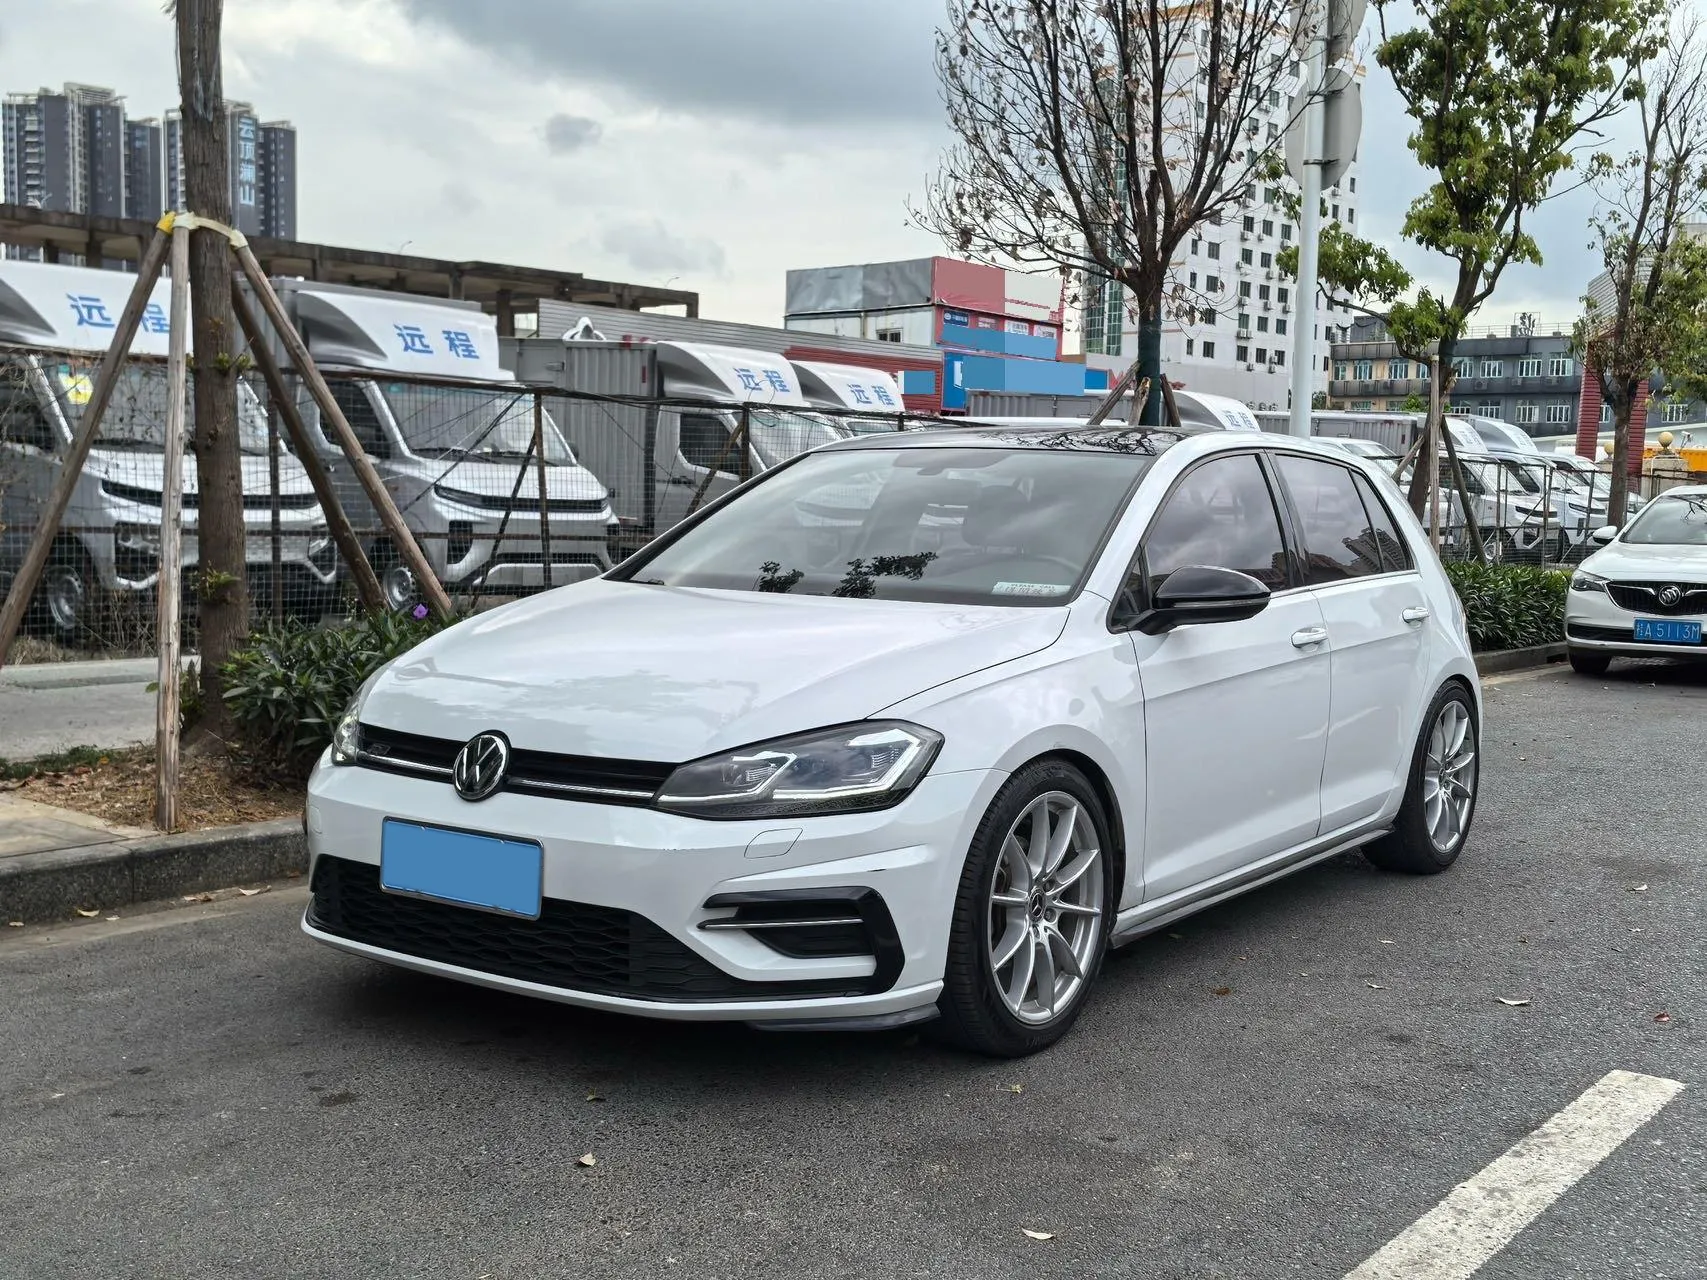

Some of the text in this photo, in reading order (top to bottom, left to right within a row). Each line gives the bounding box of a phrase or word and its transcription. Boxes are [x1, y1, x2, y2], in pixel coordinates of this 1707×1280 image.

[393, 324, 480, 359] 远程
[734, 368, 790, 393] 远程
[847, 383, 895, 406] 远程
